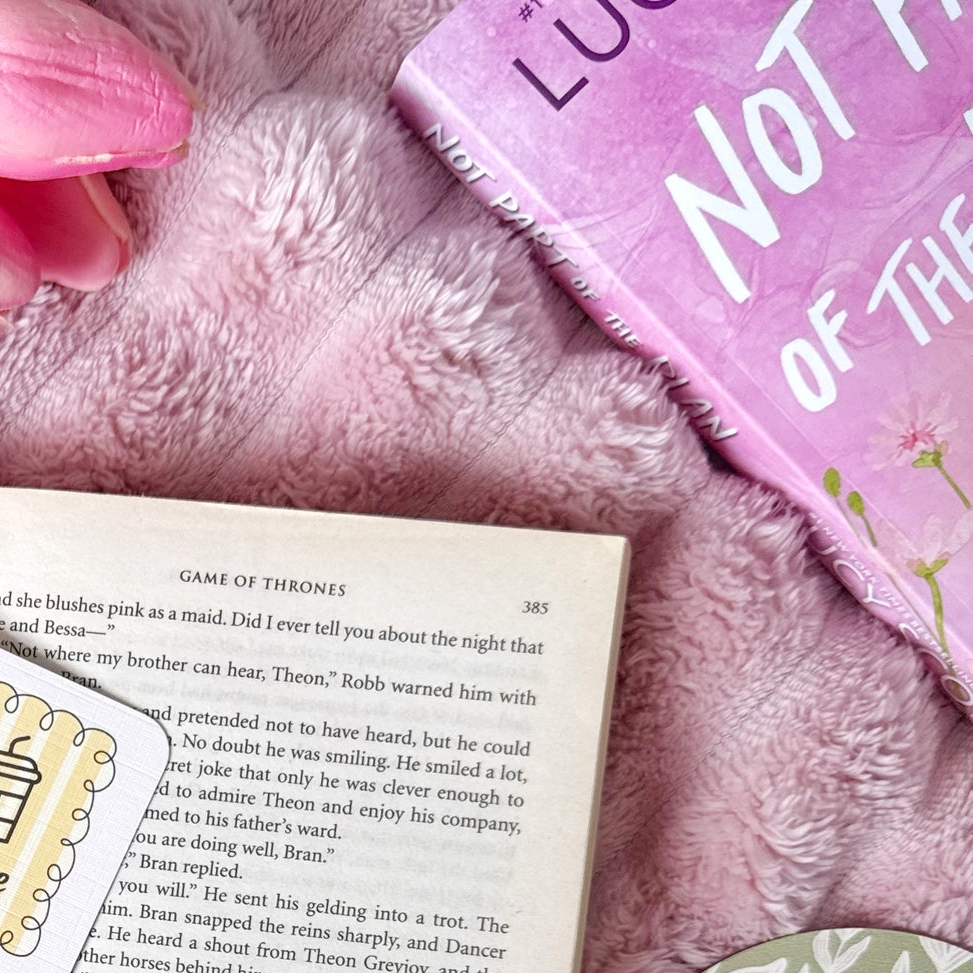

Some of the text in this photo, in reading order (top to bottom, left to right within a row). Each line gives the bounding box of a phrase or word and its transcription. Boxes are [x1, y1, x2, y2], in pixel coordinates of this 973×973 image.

[512, 0, 677, 111] LU
[664, 0, 856, 302] NOT
[425, 123, 498, 183] NOT
[489, 191, 579, 268] PART
[570, 276, 601, 301] OF
[604, 308, 642, 348] THE
[780, 193, 973, 413] OF THE
[15, 591, 43, 609] she
[45, 593, 105, 614] blushes
[106, 600, 145, 620] pink
[147, 608, 165, 620] as
[167, 609, 177, 621] a
[180, 608, 227, 626] maid.
[230, 611, 262, 629] Did
[265, 614, 274, 630] I
[276, 620, 312, 634] ever
[315, 619, 340, 637] tell
[343, 626, 375, 642] you
[377, 625, 427, 645] about
[431, 629, 458, 648] the
[461, 633, 507, 655] night
[510, 636, 545, 655] that
[179, 569, 346, 597] GAME OF THRONES
[521, 601, 549, 615] 385
[118, 880, 510, 935] you will.” He sent his gelding into a trot. The
